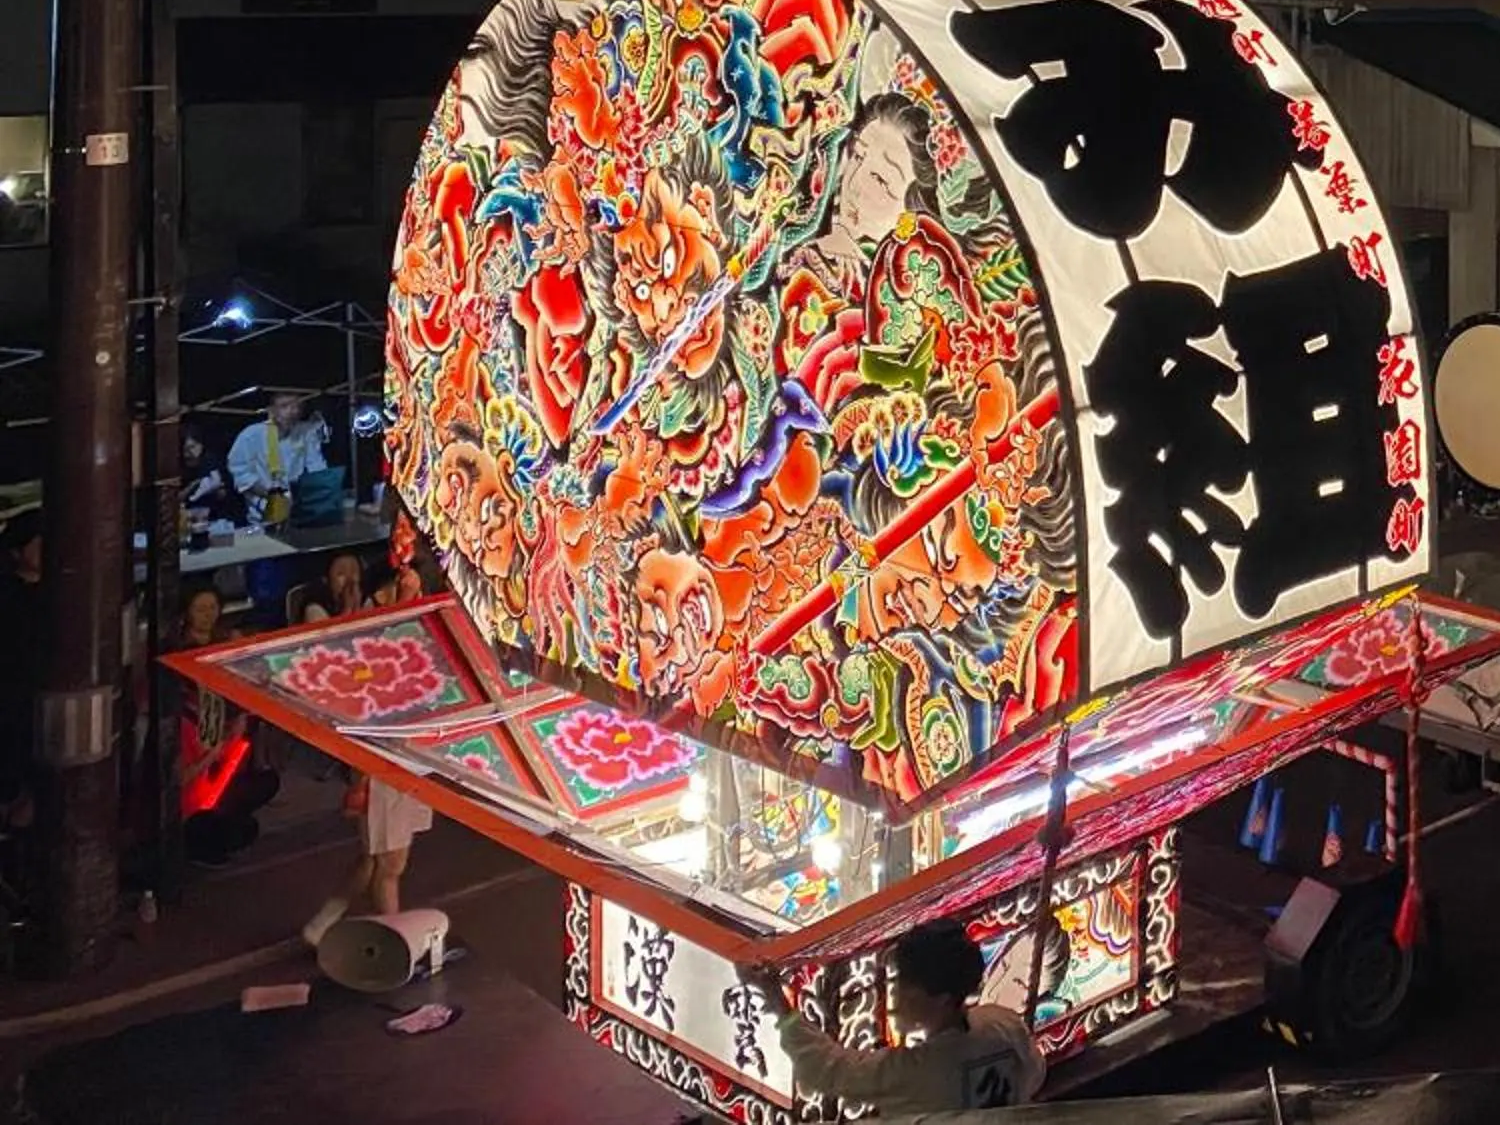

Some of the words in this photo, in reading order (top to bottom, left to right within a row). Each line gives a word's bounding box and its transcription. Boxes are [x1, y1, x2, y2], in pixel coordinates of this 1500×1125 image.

[1287, 100, 1389, 289] 若葉町
[1376, 337, 1424, 553] 花園町
